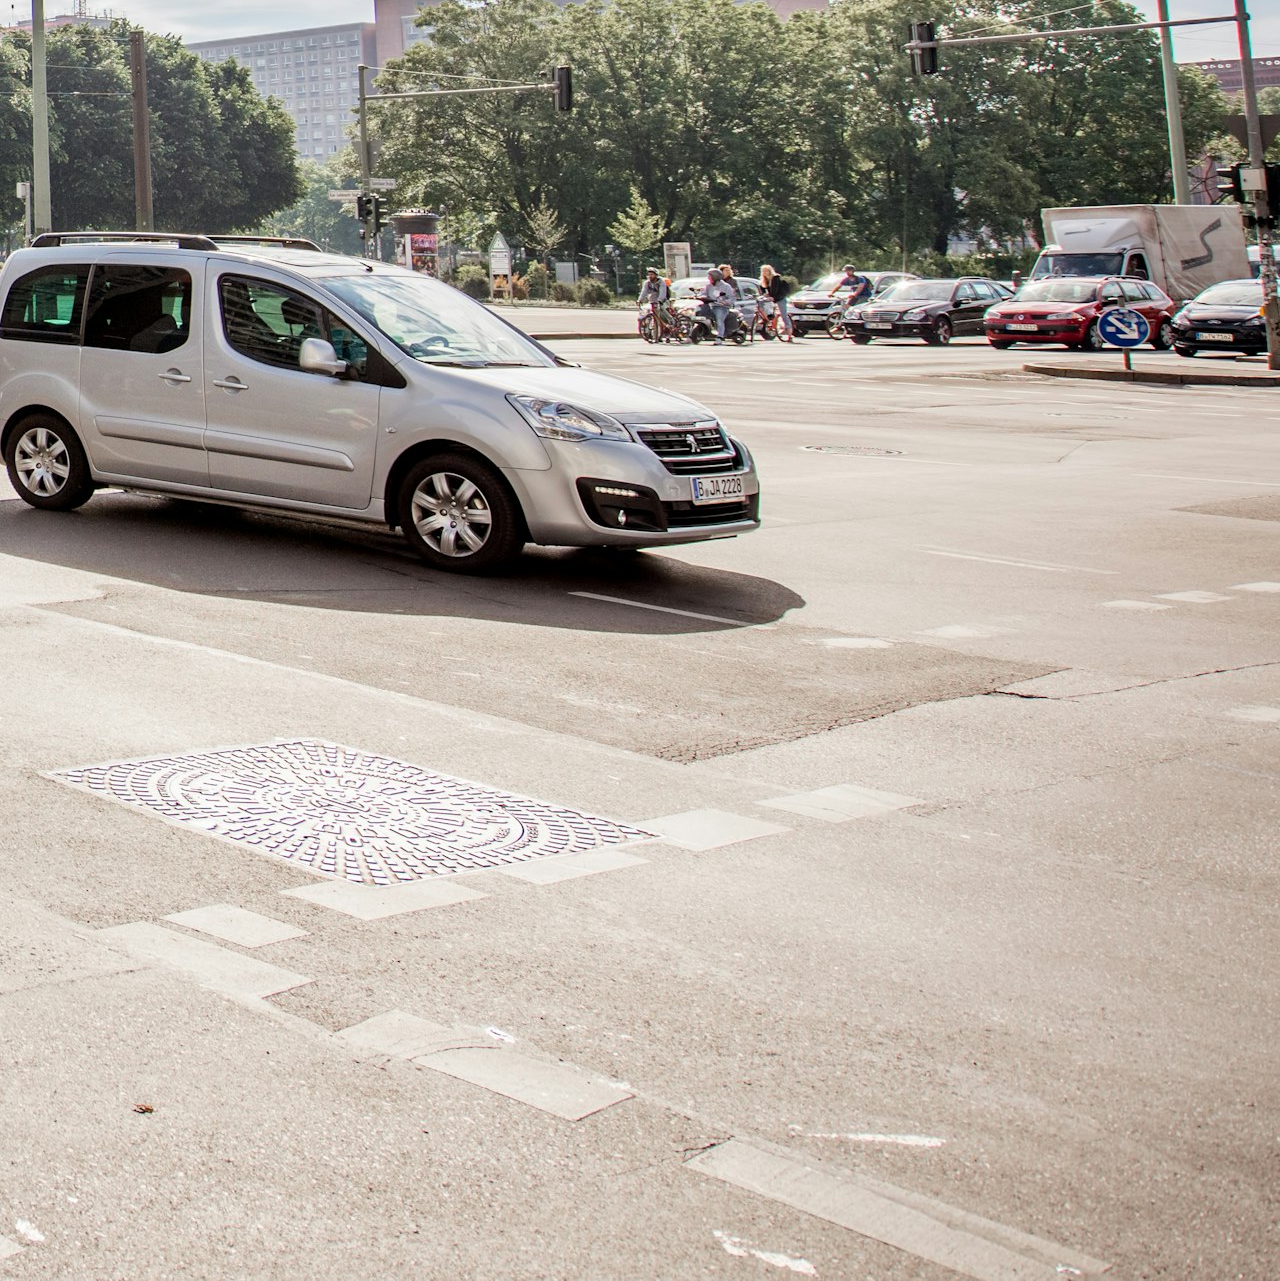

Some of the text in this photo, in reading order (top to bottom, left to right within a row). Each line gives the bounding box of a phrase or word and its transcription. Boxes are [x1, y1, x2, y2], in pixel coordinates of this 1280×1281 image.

[698, 478, 742, 496] B JA 2228
